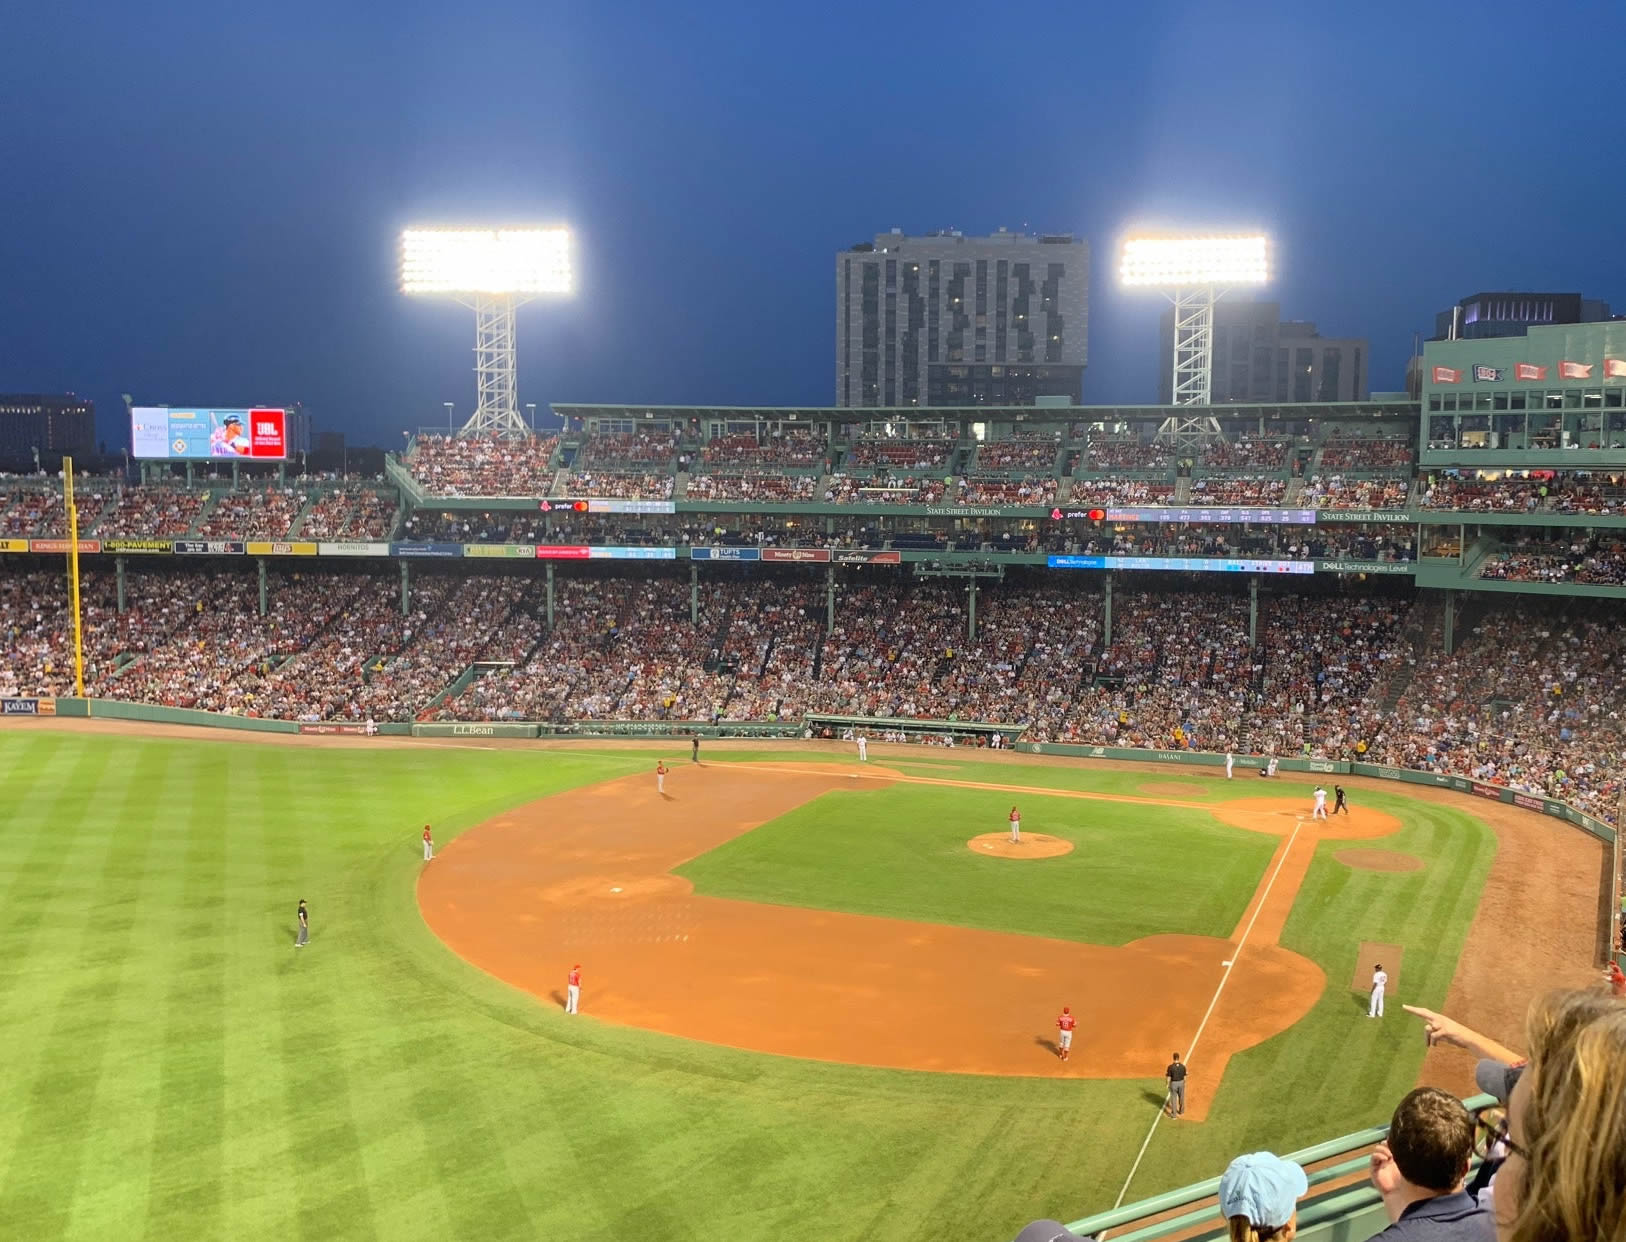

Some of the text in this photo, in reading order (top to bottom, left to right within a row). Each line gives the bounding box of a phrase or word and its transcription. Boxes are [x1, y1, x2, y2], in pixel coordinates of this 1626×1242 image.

[257, 422, 278, 435] JBL
[927, 507, 1001, 516] STATE STREET PAVILION
[1067, 511, 1087, 519] prefer
[1322, 511, 1410, 521] STATE STREET PAVILION
[104, 541, 171, 549] 1-800-PAVEMENT
[1322, 562, 1408, 572] DELL Technologies Level
[4, 701, 35, 713] KAYEM
[453, 725, 494, 735] L.L.Bean
